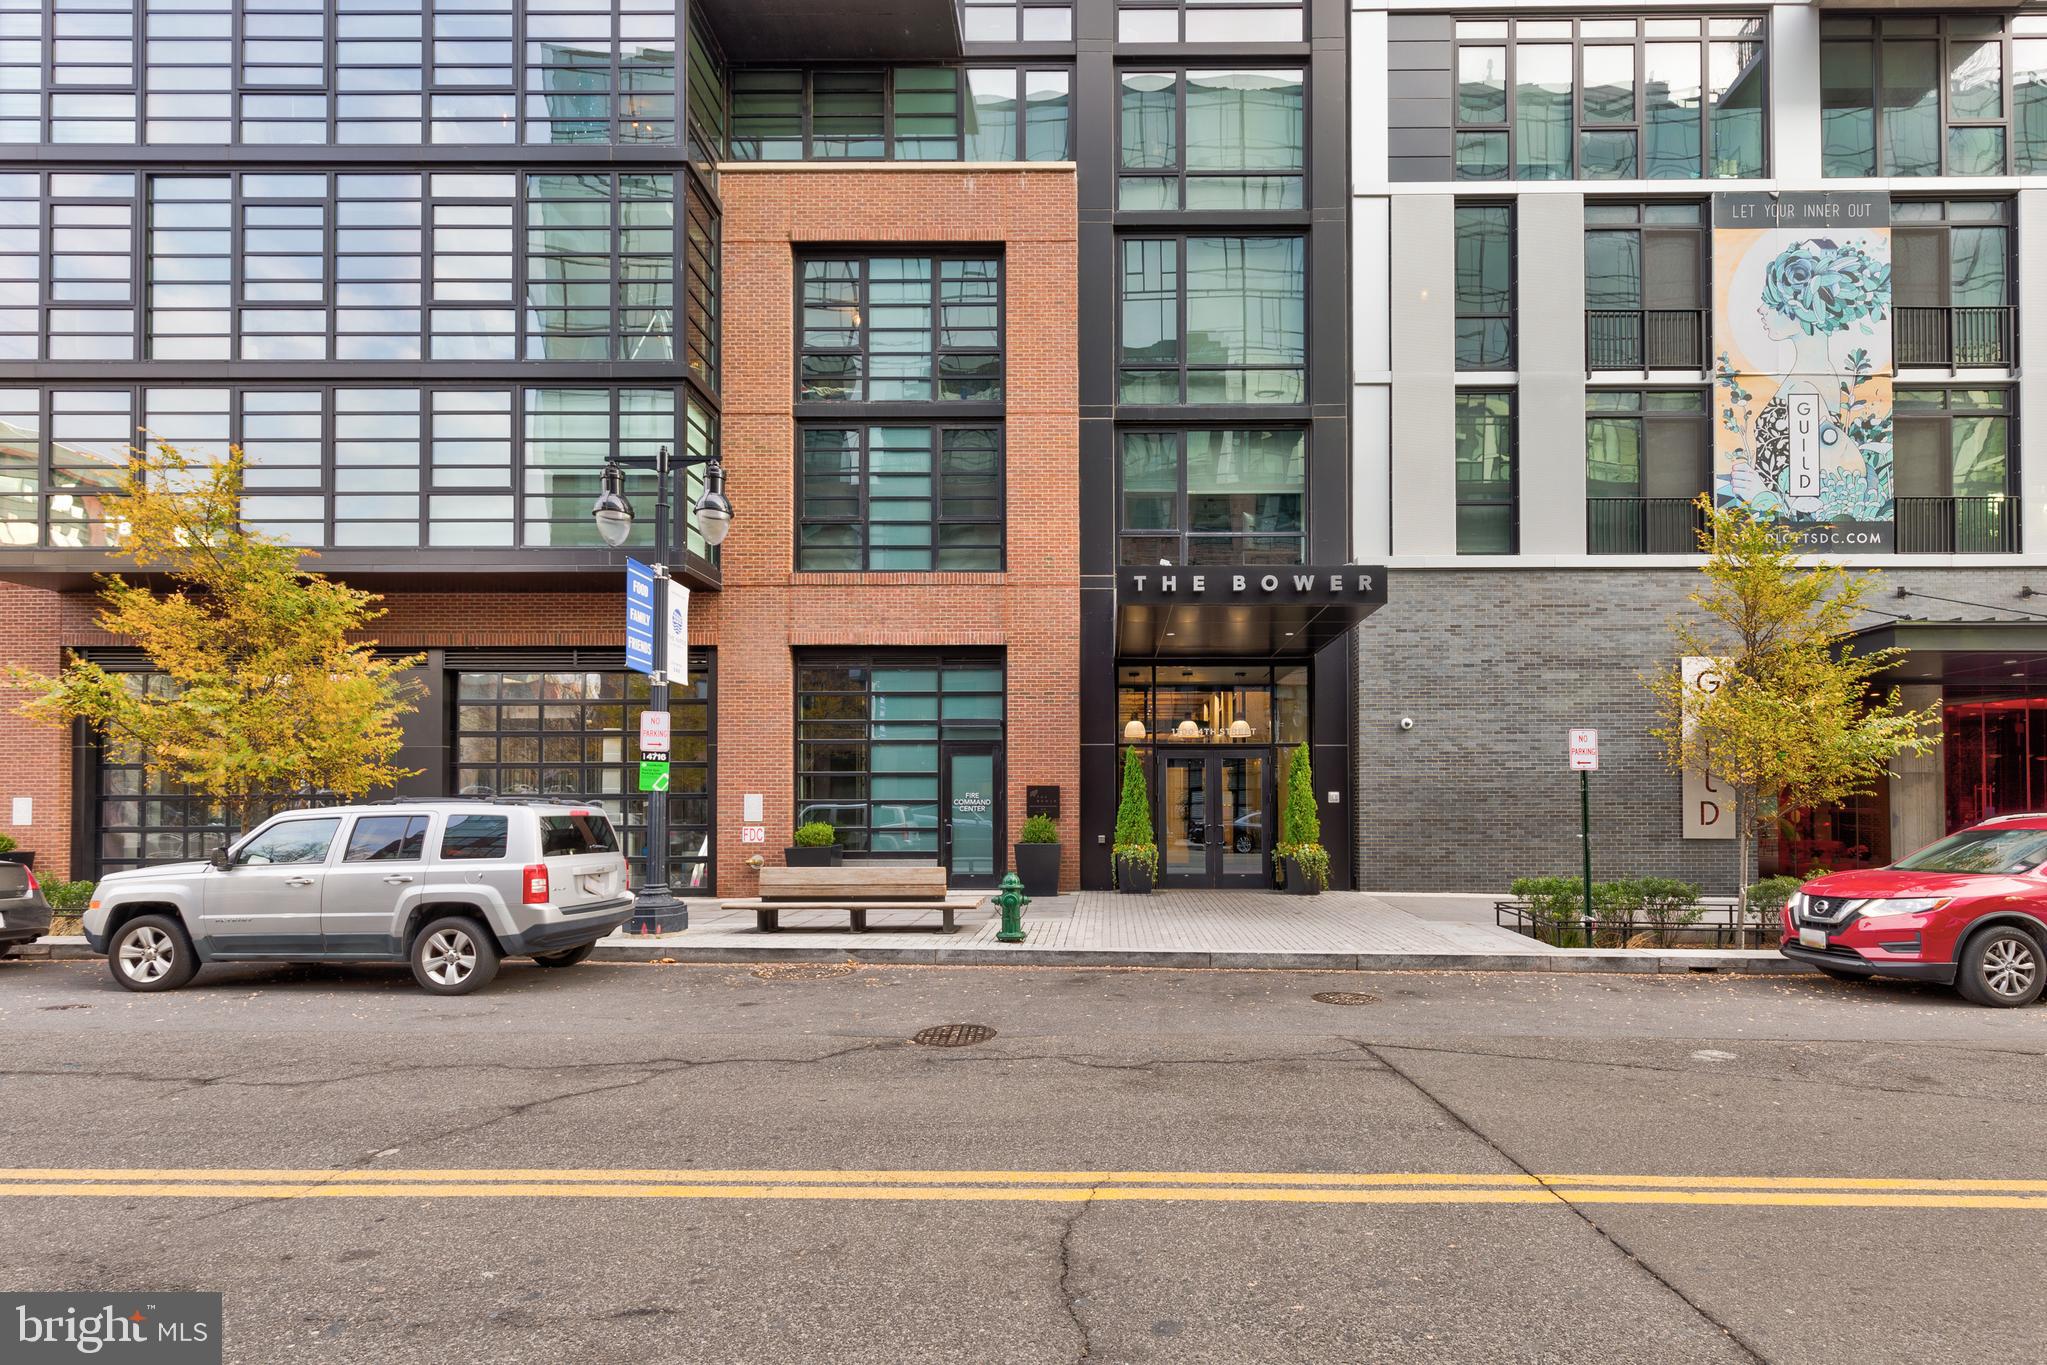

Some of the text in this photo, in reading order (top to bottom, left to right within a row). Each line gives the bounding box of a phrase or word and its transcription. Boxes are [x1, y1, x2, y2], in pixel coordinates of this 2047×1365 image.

[1732, 203, 1872, 218] LET YOUR INNER OUT
[1797, 402, 1811, 488] GUILD
[632, 580, 649, 598] FOOD
[1133, 575, 1373, 592] THE BOWER
[629, 607, 651, 626] FAMILY
[628, 635, 652, 656] FRIENDS
[650, 717, 660, 725] NO
[1578, 735, 1588, 743] NO
[1571, 747, 1596, 756] PARKING
[1696, 670, 1721, 826] GILD
[743, 828, 763, 842] FDC
